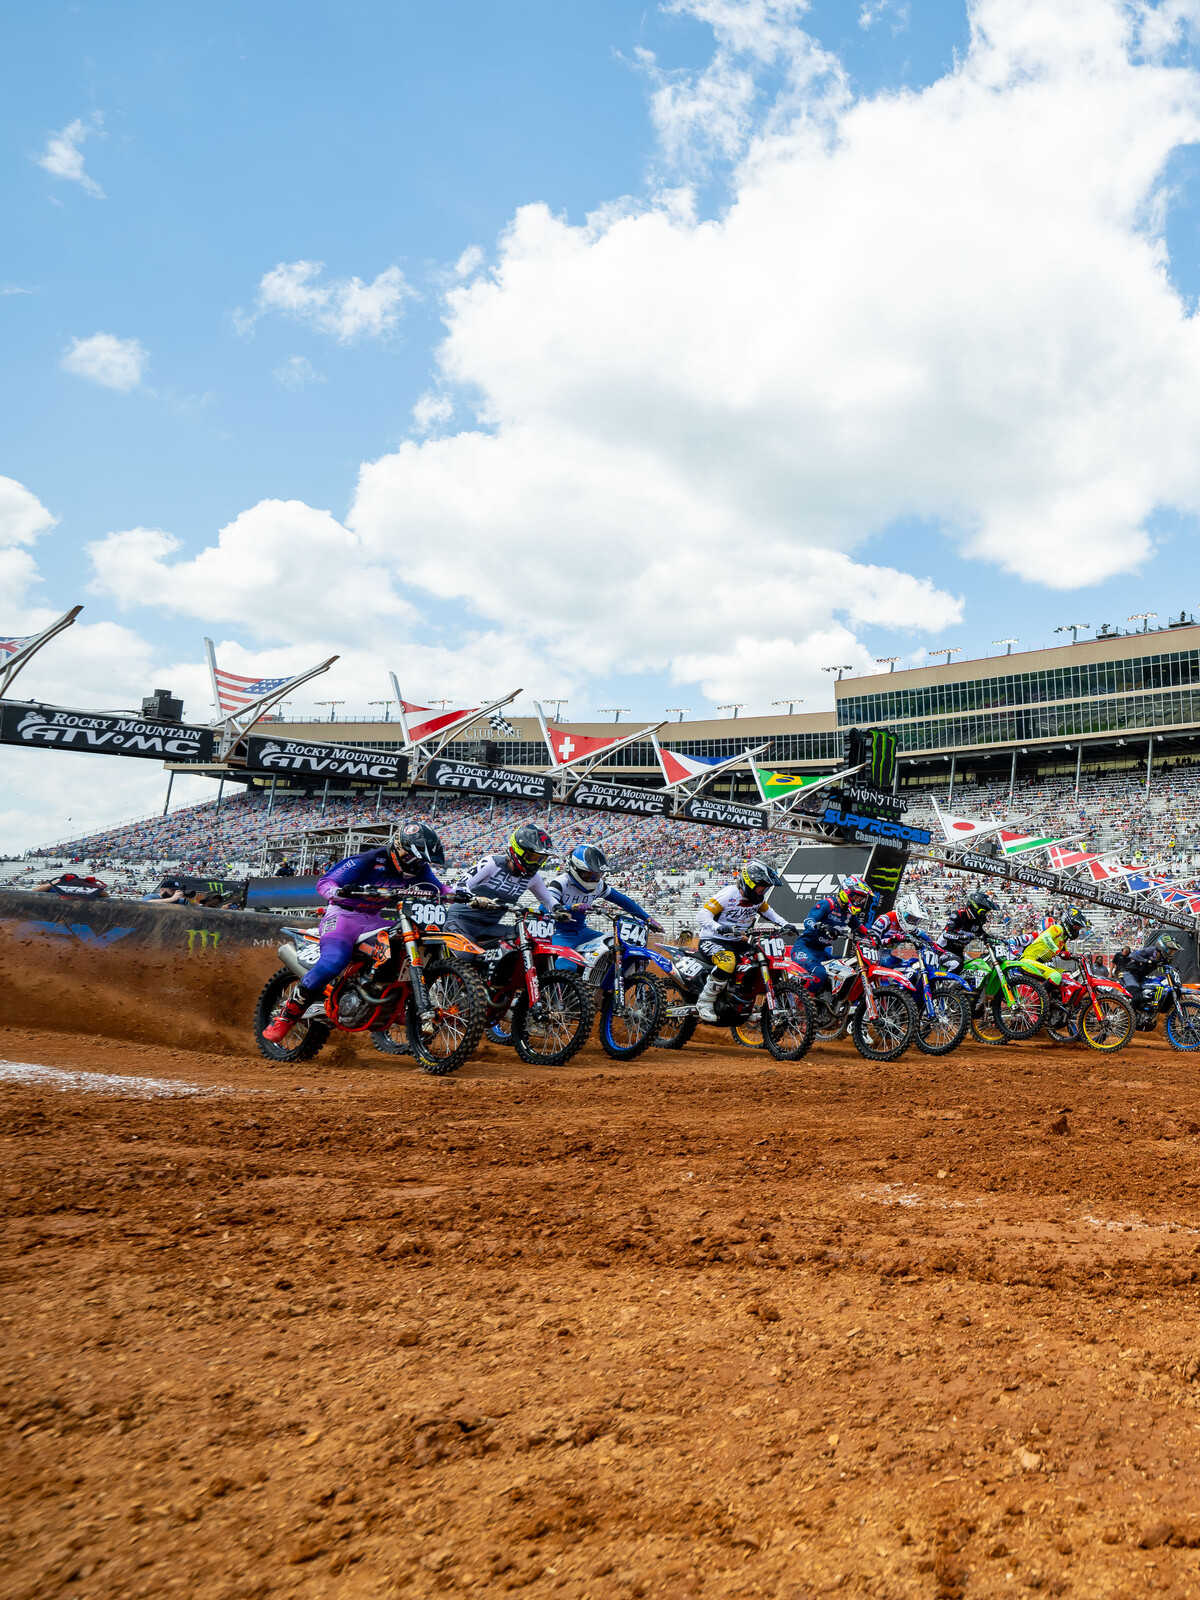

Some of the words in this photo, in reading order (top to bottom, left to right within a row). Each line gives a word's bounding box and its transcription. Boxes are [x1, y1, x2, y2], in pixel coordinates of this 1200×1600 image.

[50, 712, 113, 730] ROCKY
[115, 720, 202, 741] MOUNTAIN
[464, 728, 494, 739] CLUB
[497, 728, 522, 739] ONE
[283, 742, 330, 757] ROCKY
[329, 748, 400, 765] MOUNTAIN
[455, 764, 490, 778] ROCKY
[492, 770, 545, 785] MOUNTAIN
[591, 784, 620, 797] ROCKY
[620, 789, 665, 802] MOUNTAIN
[850, 788, 907, 811] MONSTER
[702, 801, 727, 811] ROCKY
[727, 805, 763, 818] MOUNTAIN
[858, 804, 899, 818] ENERGY
[823, 809, 932, 845] SUPERCROSS
[855, 830, 903, 850] Championship
[411, 903, 446, 925] 366
[527, 919, 555, 938] 464
[620, 922, 646, 947] 544
[761, 938, 785, 957] 119
